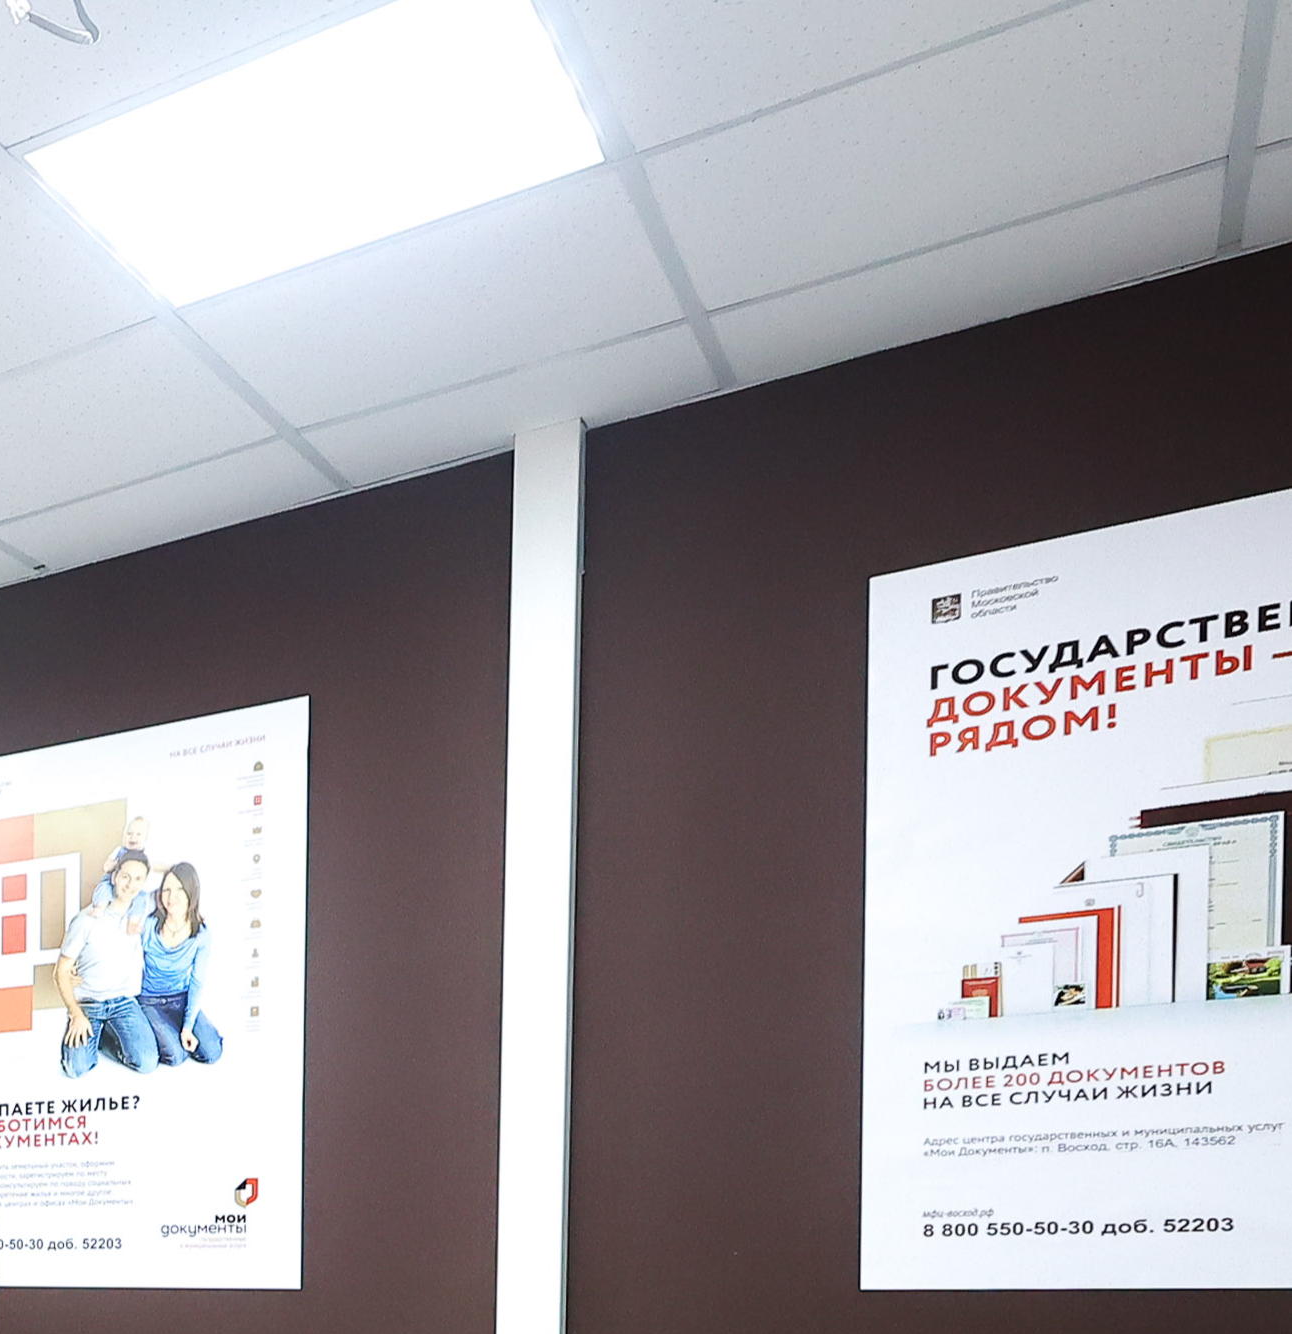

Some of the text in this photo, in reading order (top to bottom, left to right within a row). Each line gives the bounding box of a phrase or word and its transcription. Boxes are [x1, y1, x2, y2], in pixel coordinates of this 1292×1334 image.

[971, 575, 1059, 599] Правительство
[971, 589, 1039, 609] Московской
[971, 605, 1017, 619] области
[930, 602, 1292, 691] ГОСУДАРСТВЕ
[926, 645, 1253, 728] ДОКУМЕНТЫ
[929, 704, 1117, 757] РЯДОМ!
[924, 1051, 1070, 1074] МЫ ВЫДАЕМ
[923, 1060, 1226, 1092] БОЛЕЕ 200 ДОКУМЕНТОВ
[61, 1095, 141, 1114] ЖИЛЬЕ?
[922, 1081, 1213, 1110] НА ВСЕ СЛУЧАИ ЖИЗНИ
[923, 1136, 959, 1148] Адрес
[963, 1134, 1005, 1146] центра
[1009, 1129, 1117, 1144] государственных
[1134, 1123, 1243, 1138] муниципальных
[1247, 1121, 1285, 1134] услуг
[923, 1147, 955, 1158] «Мои
[1115, 1140, 1141, 1153] стр.
[1183, 1135, 1236, 1147] 143562
[161, 1224, 246, 1237] документы
[923, 1217, 1235, 1237] 8 800 550-50-30 доб. 52203
[47, 1238, 77, 1251] доб.
[82, 1238, 122, 1250] 52203
